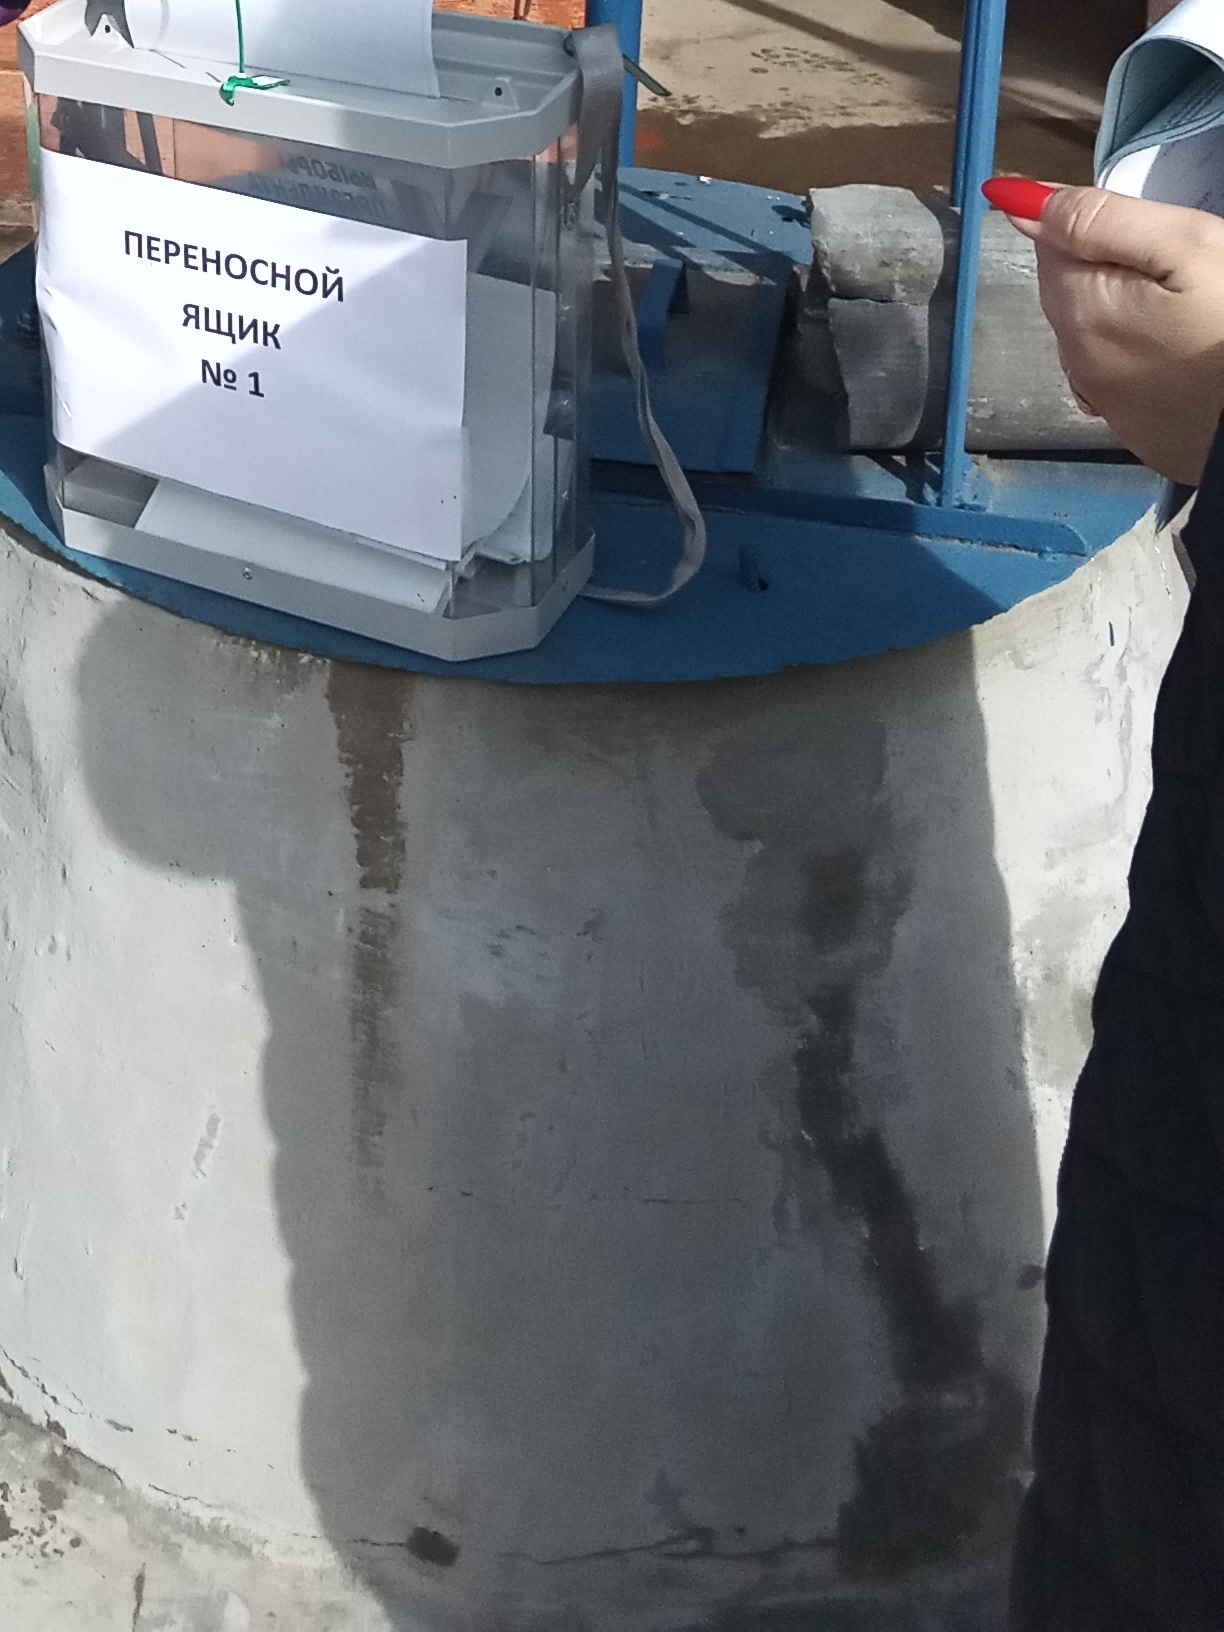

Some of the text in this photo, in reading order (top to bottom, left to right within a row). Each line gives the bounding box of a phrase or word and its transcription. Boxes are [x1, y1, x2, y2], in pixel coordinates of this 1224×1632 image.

[124, 230, 344, 302] ПЕРЕНОСНОЙ
[182, 303, 281, 350] ЯЩИК
[201, 358, 265, 398] № 1
